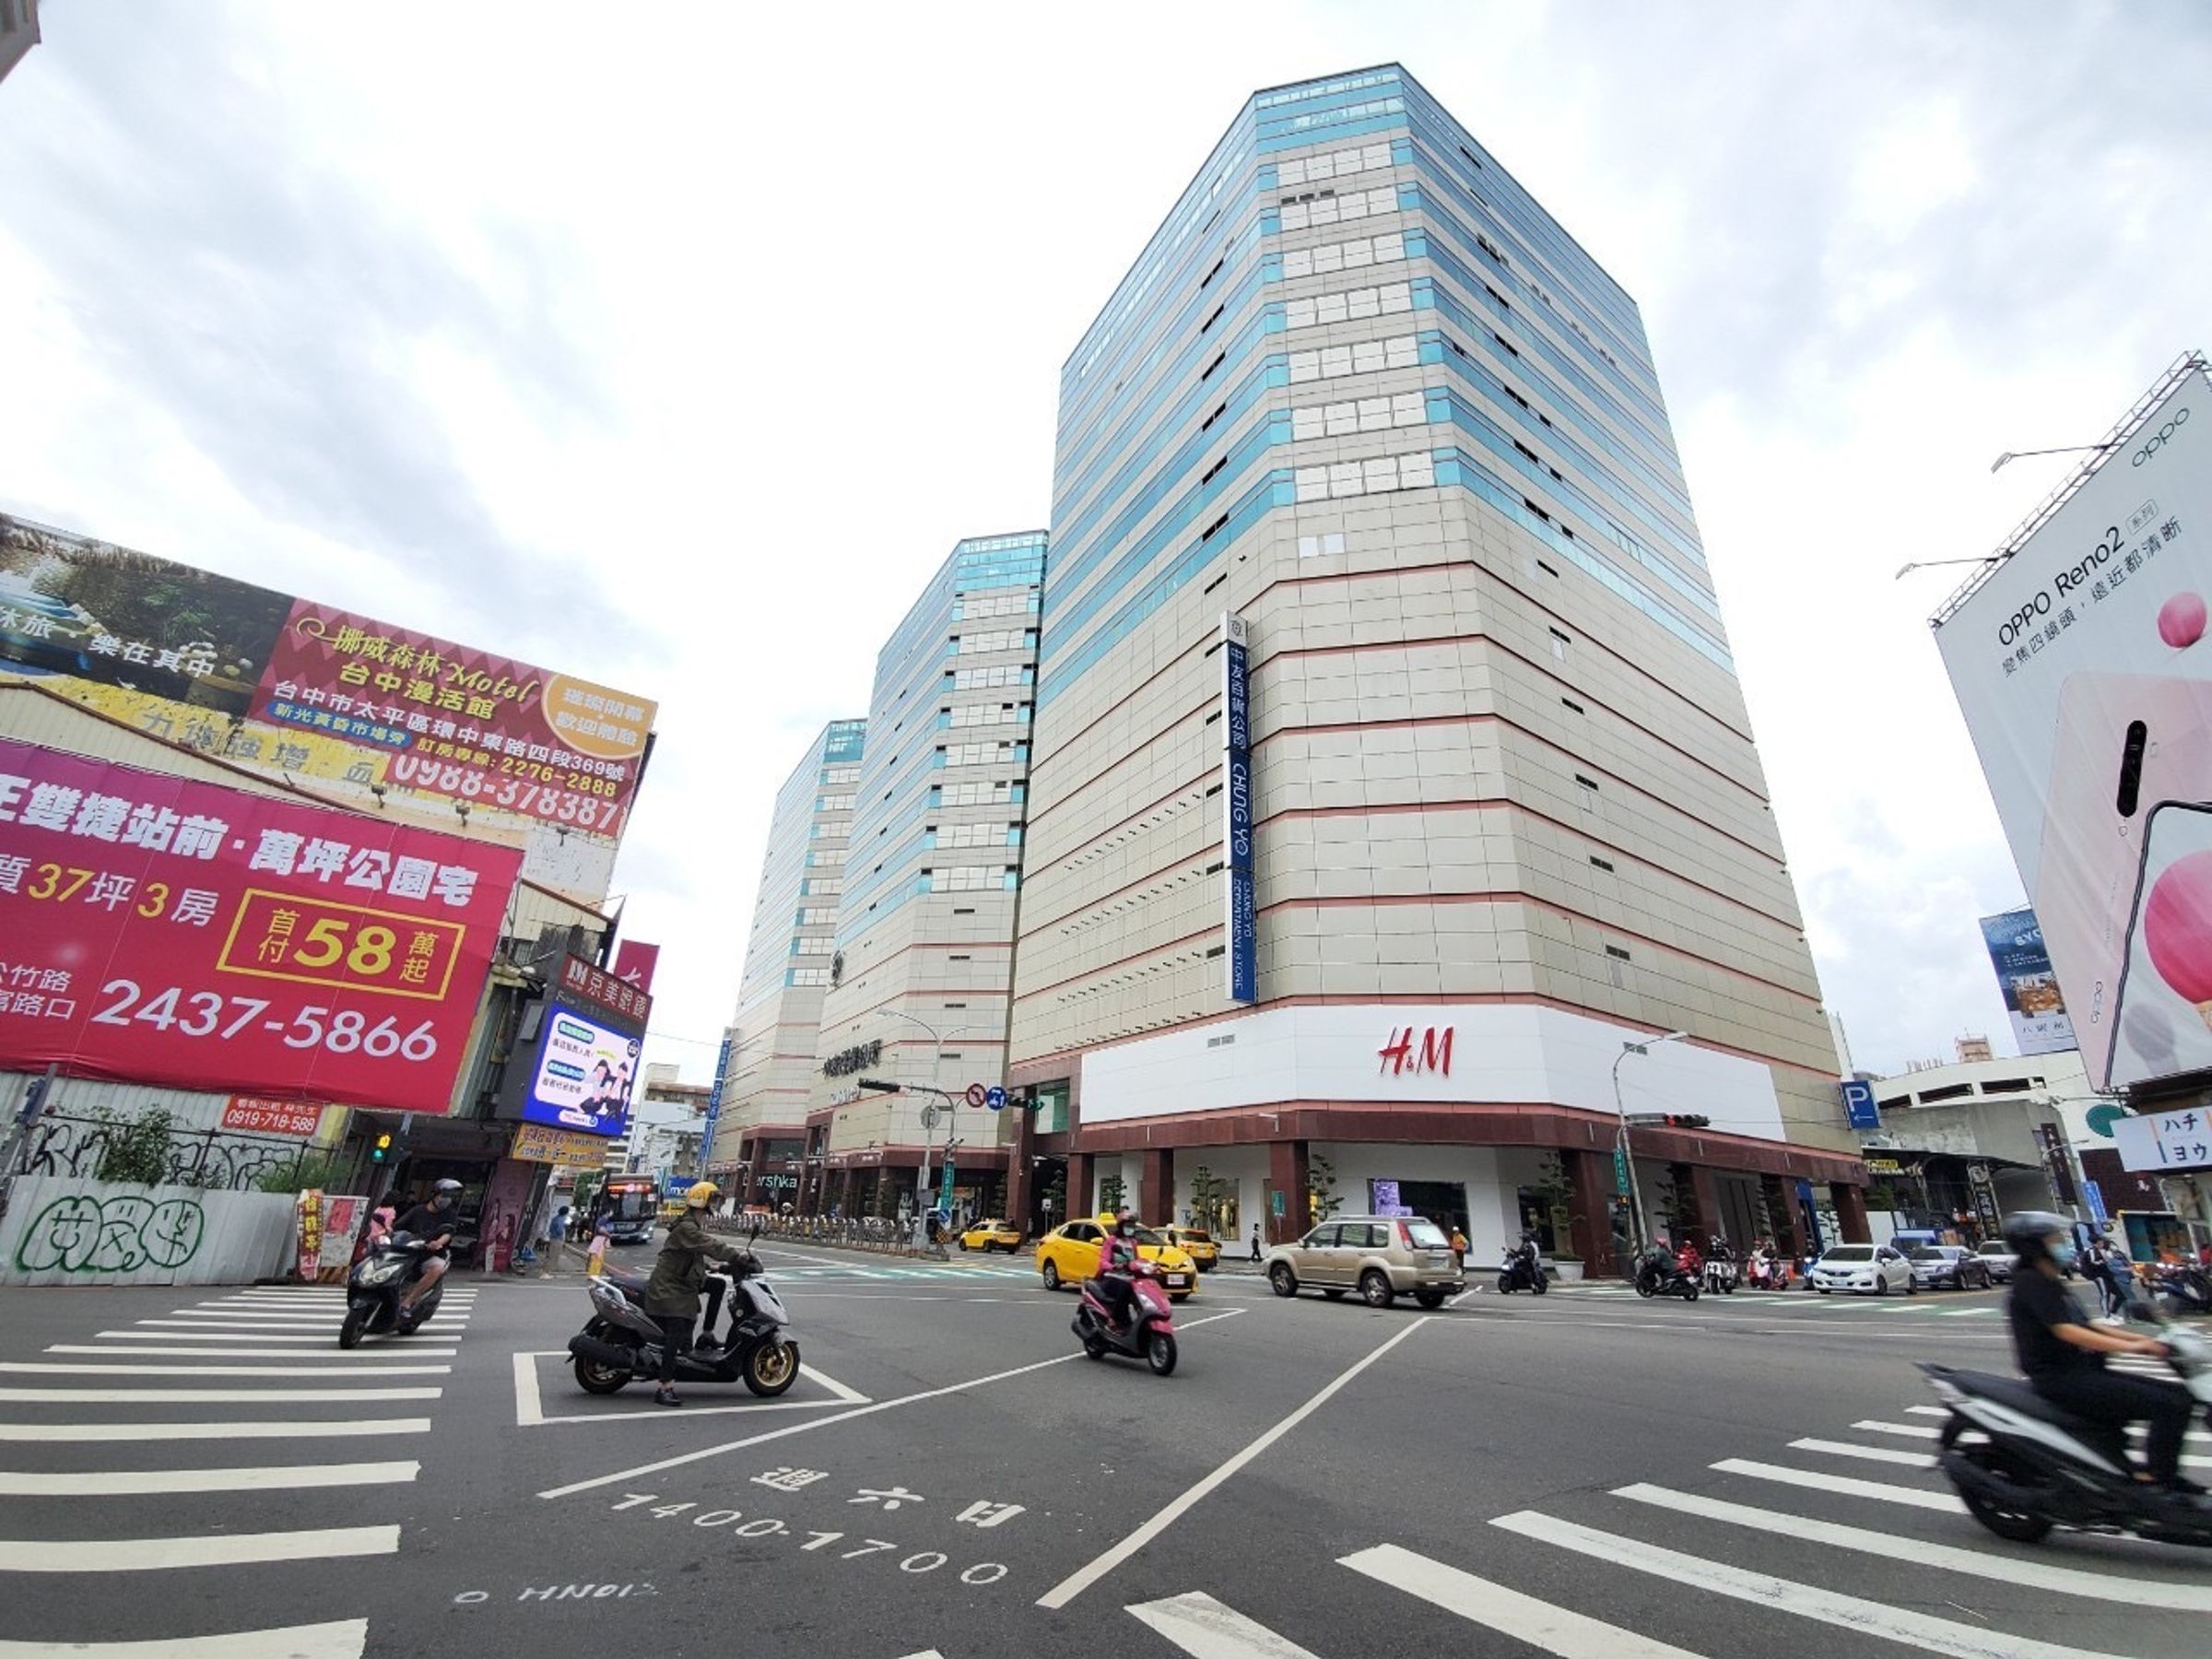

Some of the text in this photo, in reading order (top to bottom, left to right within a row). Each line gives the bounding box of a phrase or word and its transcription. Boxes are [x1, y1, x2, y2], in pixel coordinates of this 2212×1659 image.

[1999, 526, 2124, 645] OPPO Reno2
[334, 625, 540, 703] 挪威森林 Motel
[340, 662, 496, 720] 台中漫活館
[500, 757, 617, 797] 2276-2888
[1233, 763, 1249, 856] CHUNG YO
[294, 918, 396, 975] 58
[90, 979, 438, 1062] 2437-5866
[1378, 1026, 1454, 1078] H&M
[227, 1109, 315, 1131] 0919-718-588
[1845, 1086, 1869, 1112] P
[2164, 1112, 2197, 1132] ハチ
